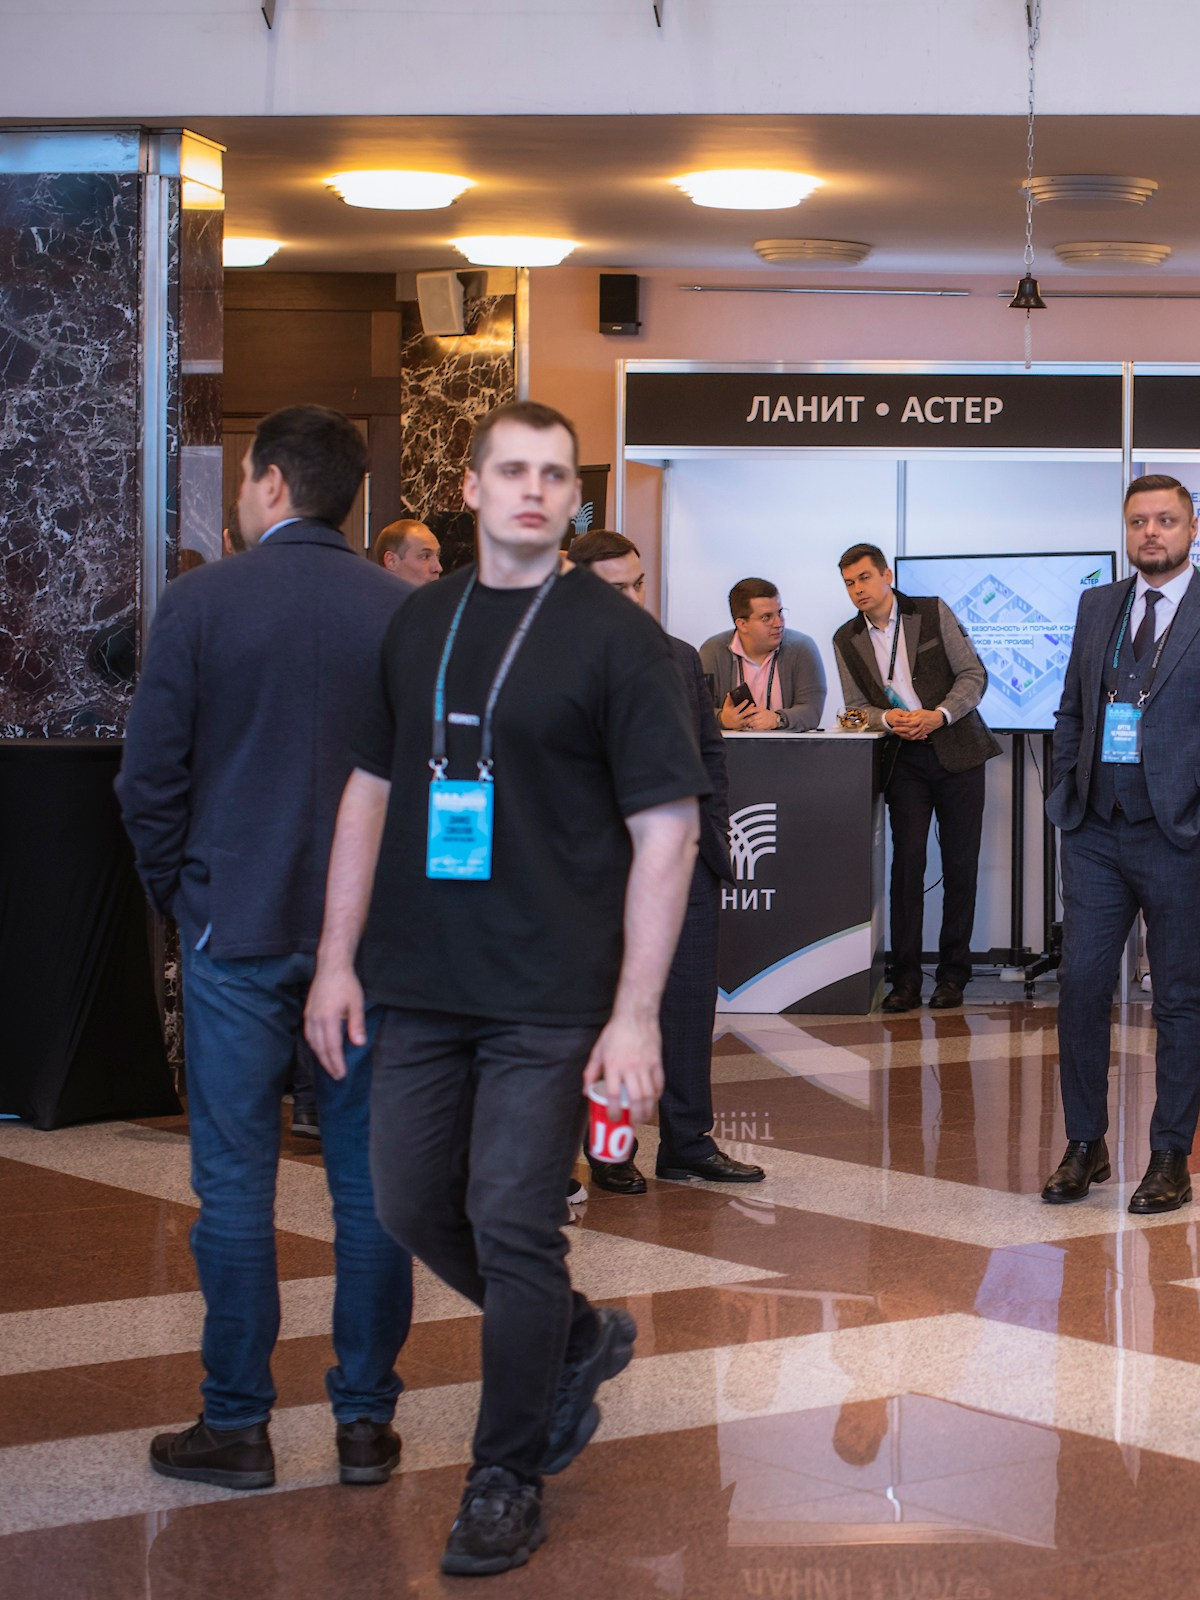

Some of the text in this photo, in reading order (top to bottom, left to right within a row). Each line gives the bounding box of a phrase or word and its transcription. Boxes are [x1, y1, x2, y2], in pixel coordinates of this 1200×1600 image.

[745, 395, 1004, 424] ЛАНИТ АСТЕР
[721, 887, 777, 911] НИТ
